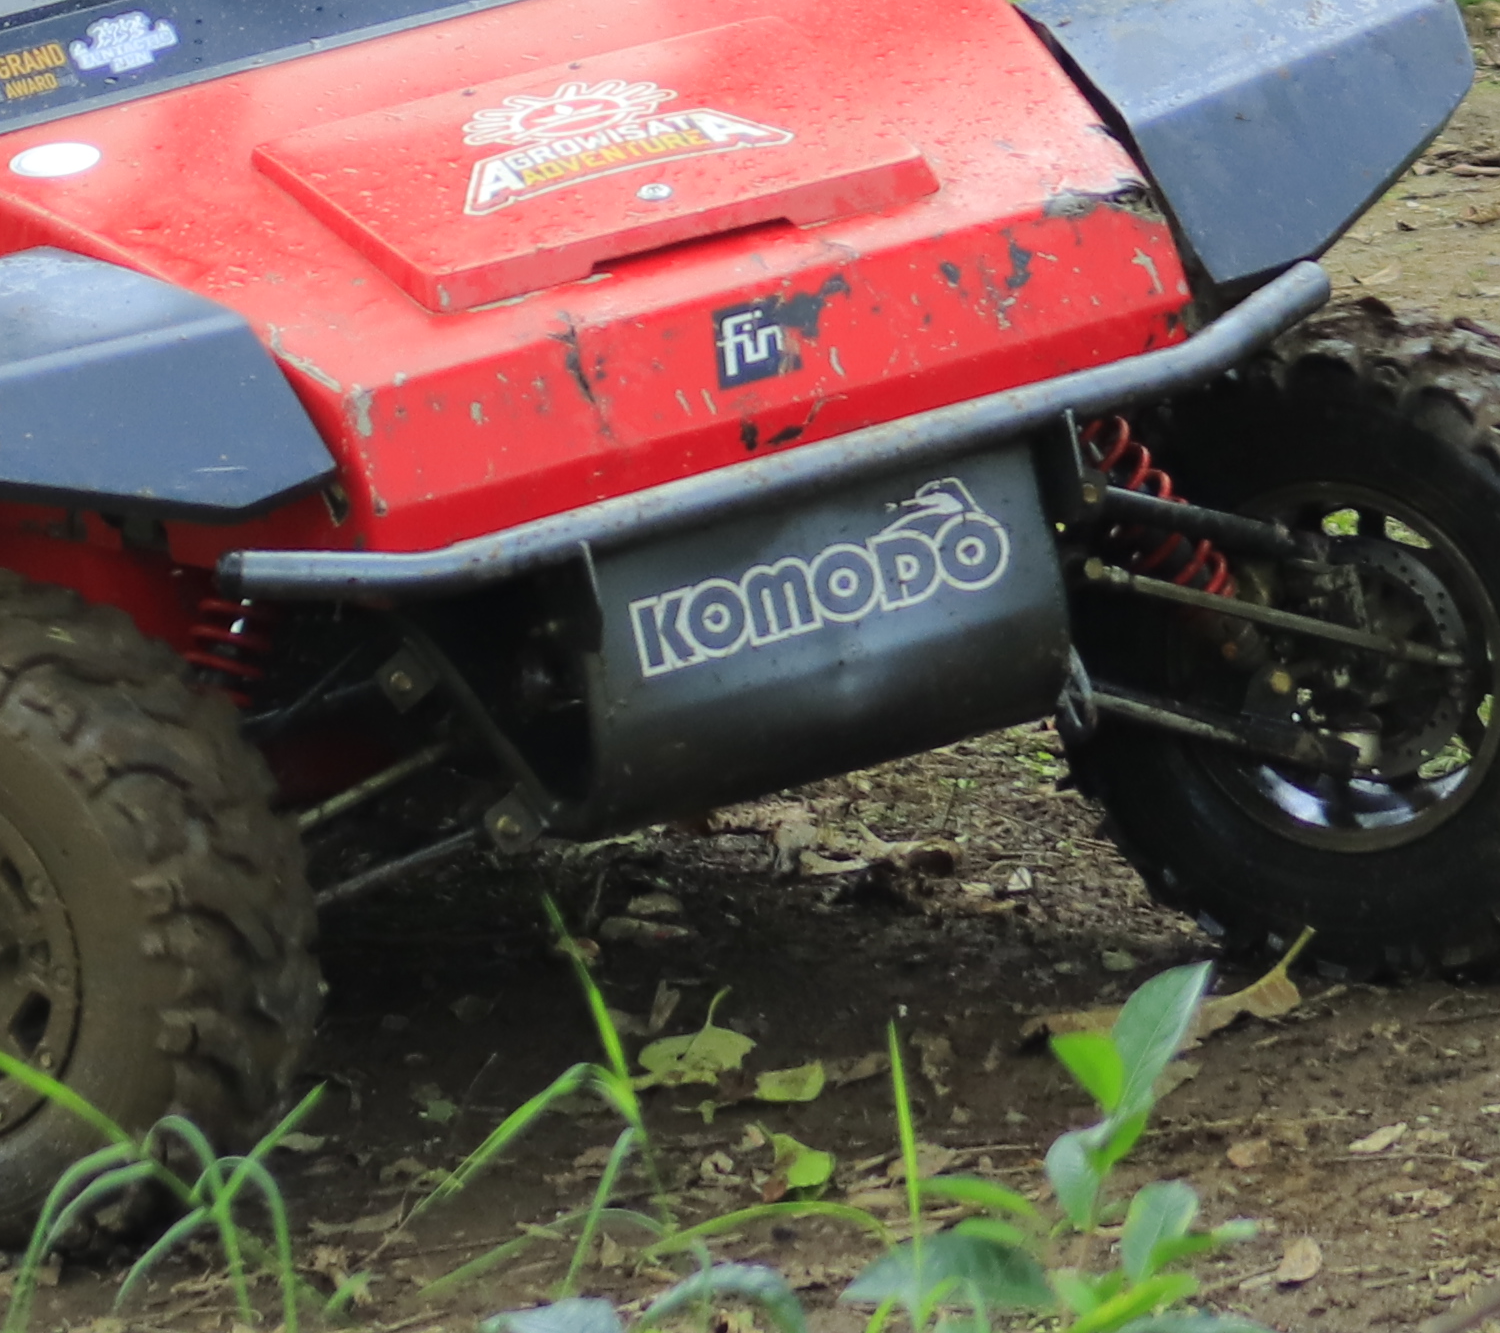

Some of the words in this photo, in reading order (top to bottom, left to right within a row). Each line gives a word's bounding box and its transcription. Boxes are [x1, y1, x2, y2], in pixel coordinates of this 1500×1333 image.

[5, 73, 59, 100] AWARD
[477, 112, 772, 205] AGROWISATA
[521, 127, 712, 186] ADVENTURE
[628, 510, 1011, 678] KOMODO
